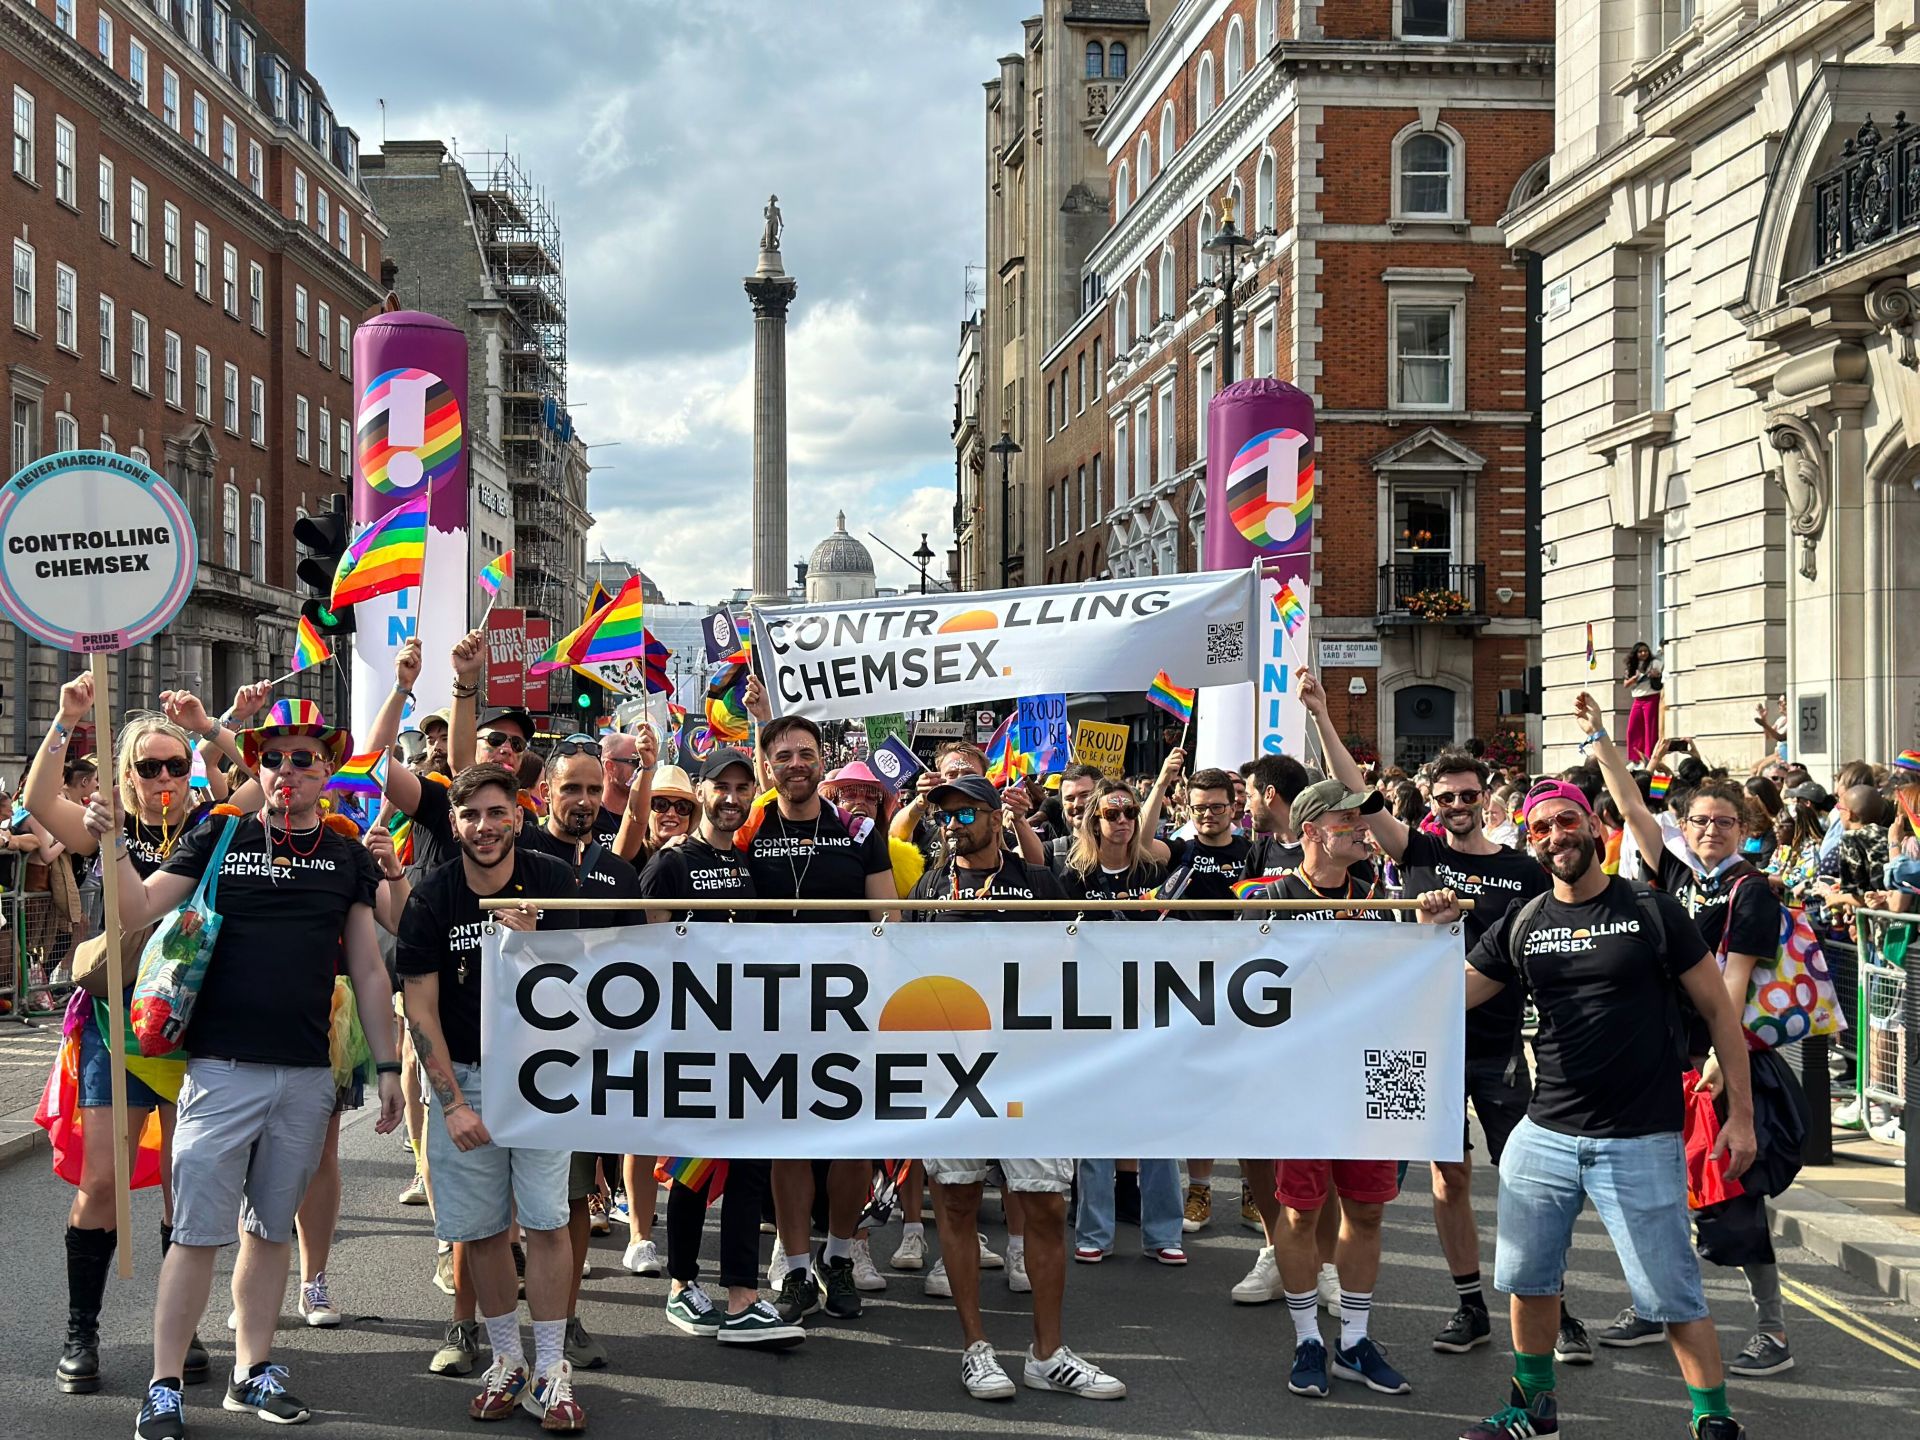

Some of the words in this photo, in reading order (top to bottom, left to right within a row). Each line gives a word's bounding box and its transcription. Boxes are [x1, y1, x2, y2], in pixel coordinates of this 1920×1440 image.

[15, 462, 56, 490] NEVER
[56, 455, 106, 469] MARCH
[108, 457, 151, 483] ALONE
[8, 527, 170, 554] CONTROLLING
[35, 553, 150, 578] CHEMSEX
[488, 627, 525, 646] JERSEY
[490, 643, 523, 664] BOYS
[1021, 699, 1064, 721] PROUD
[1802, 706, 1817, 731] 55
[1021, 726, 1042, 747] TO
[1049, 723, 1065, 745] BE
[1079, 728, 1124, 752] PROUD
[1078, 749, 1087, 760] TO
[1089, 751, 1097, 760] BE
[1100, 752, 1104, 762] A
[1107, 754, 1122, 764] GAY
[893, 769, 913, 789] TESTING
[518, 1048, 1024, 1121] CHEMSEX.
